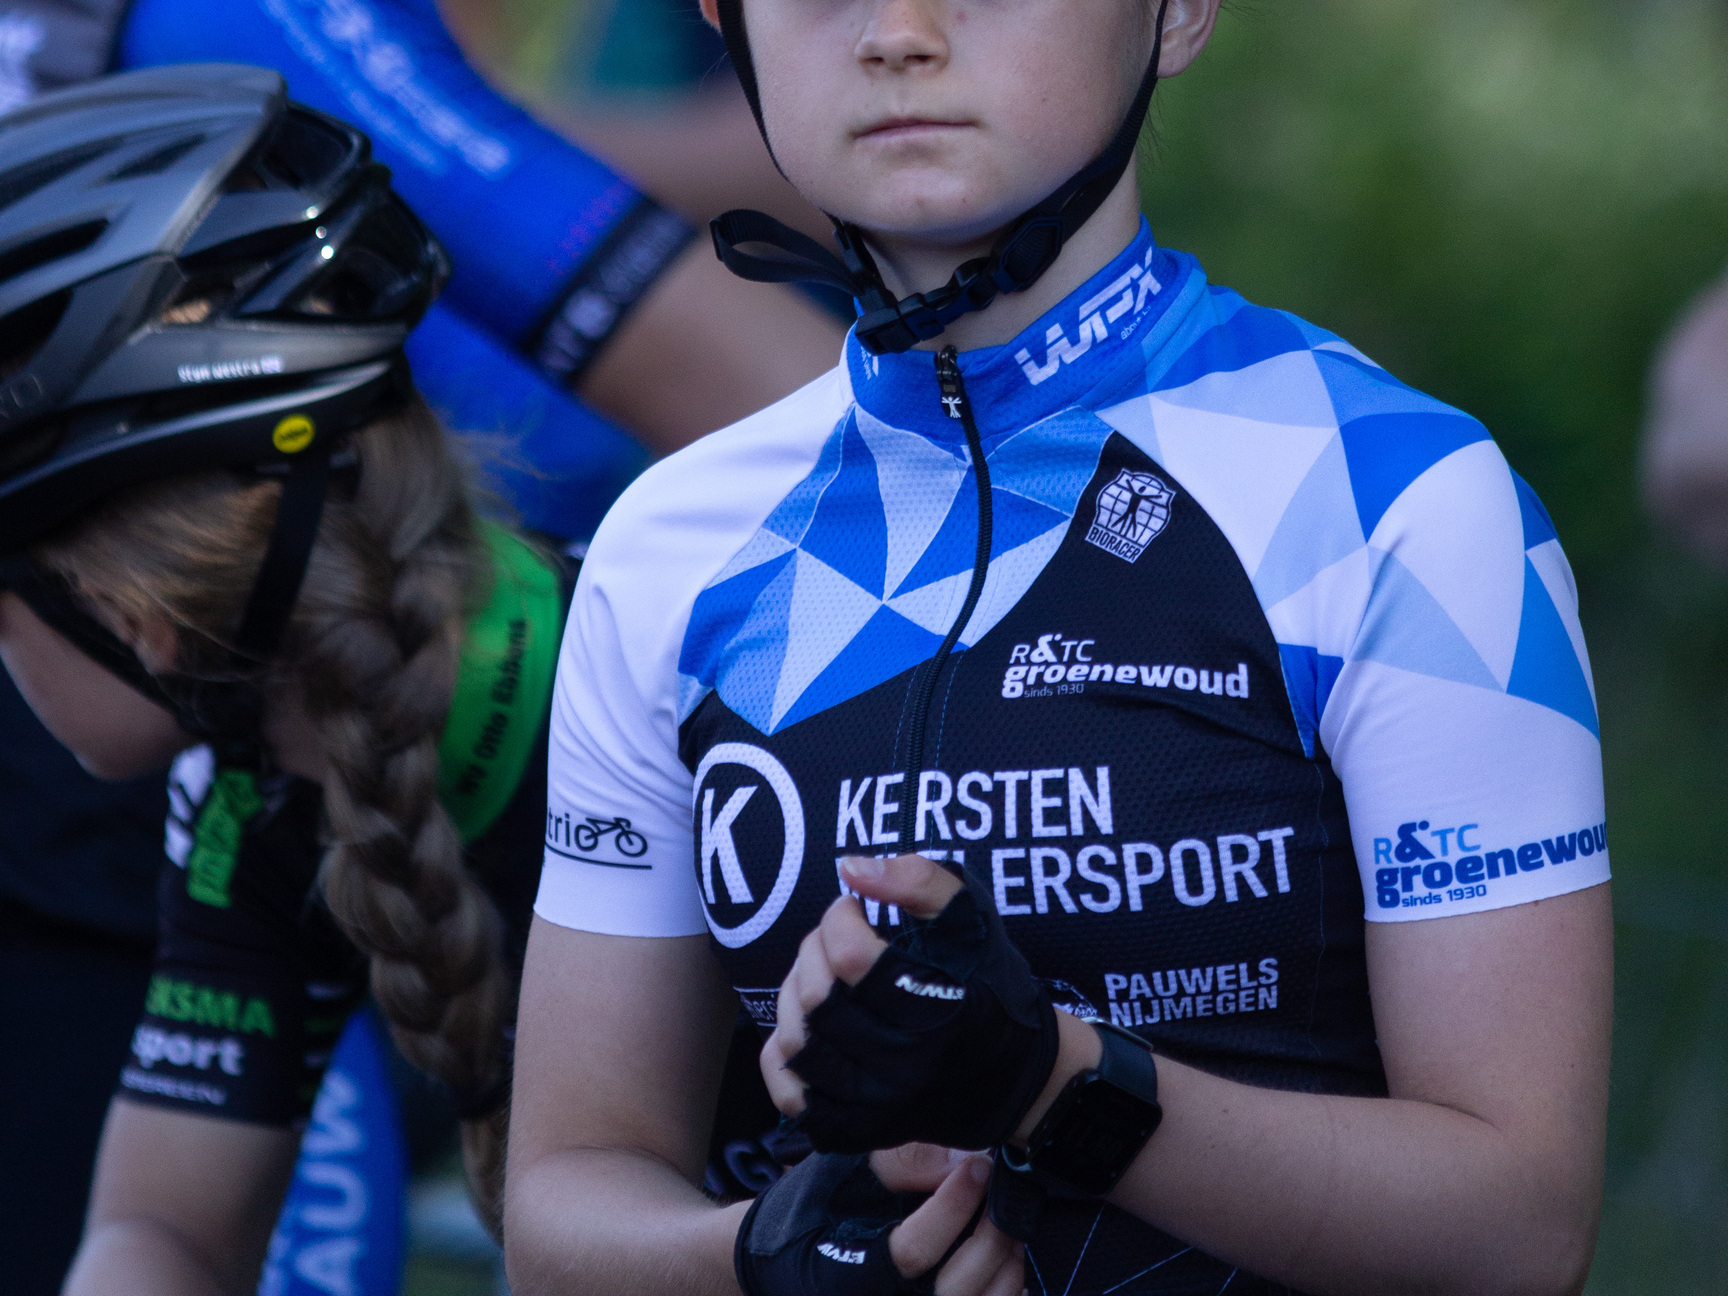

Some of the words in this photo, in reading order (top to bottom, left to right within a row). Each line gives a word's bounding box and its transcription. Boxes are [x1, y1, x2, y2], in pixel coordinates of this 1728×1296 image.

[1088, 526, 1141, 561] BIORACER
[1009, 633, 1096, 665] R&TC
[1001, 662, 1249, 699] groenewoud
[1024, 687, 1053, 698] sinds
[1057, 683, 1085, 696] 1930
[836, 766, 1114, 848] KERSTEN
[701, 785, 758, 905] K
[1373, 820, 1482, 865] R&TC
[1376, 821, 1608, 909] groenewou
[1402, 891, 1442, 908] sinds
[1446, 884, 1487, 902] 1930
[1104, 957, 1279, 1000] PAUWELS
[1108, 985, 1279, 1028] NIJMEGEN
